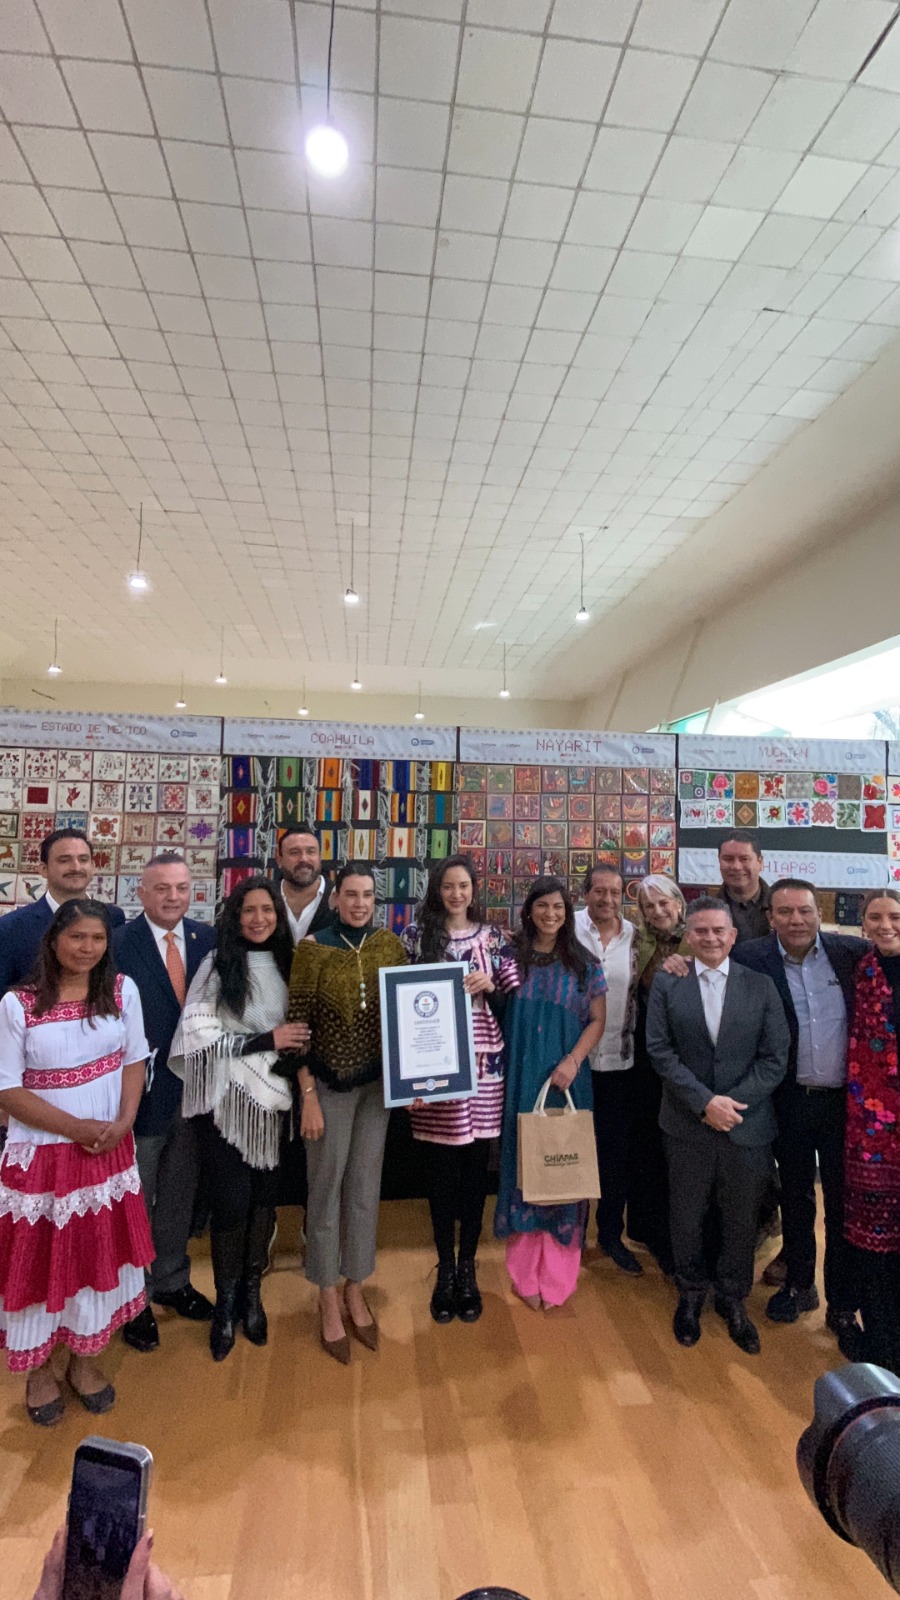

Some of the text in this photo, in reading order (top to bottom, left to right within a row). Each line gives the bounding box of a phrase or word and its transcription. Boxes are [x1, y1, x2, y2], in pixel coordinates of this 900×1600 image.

[41, 721, 82, 732] ESTADO
[88, 723, 102, 733] DE
[310, 732, 375, 746] COAHUILA
[535, 737, 602, 753] NAYARIT
[762, 860, 817, 875] HIAPAS
[544, 1152, 579, 1163] CHIAPAS
